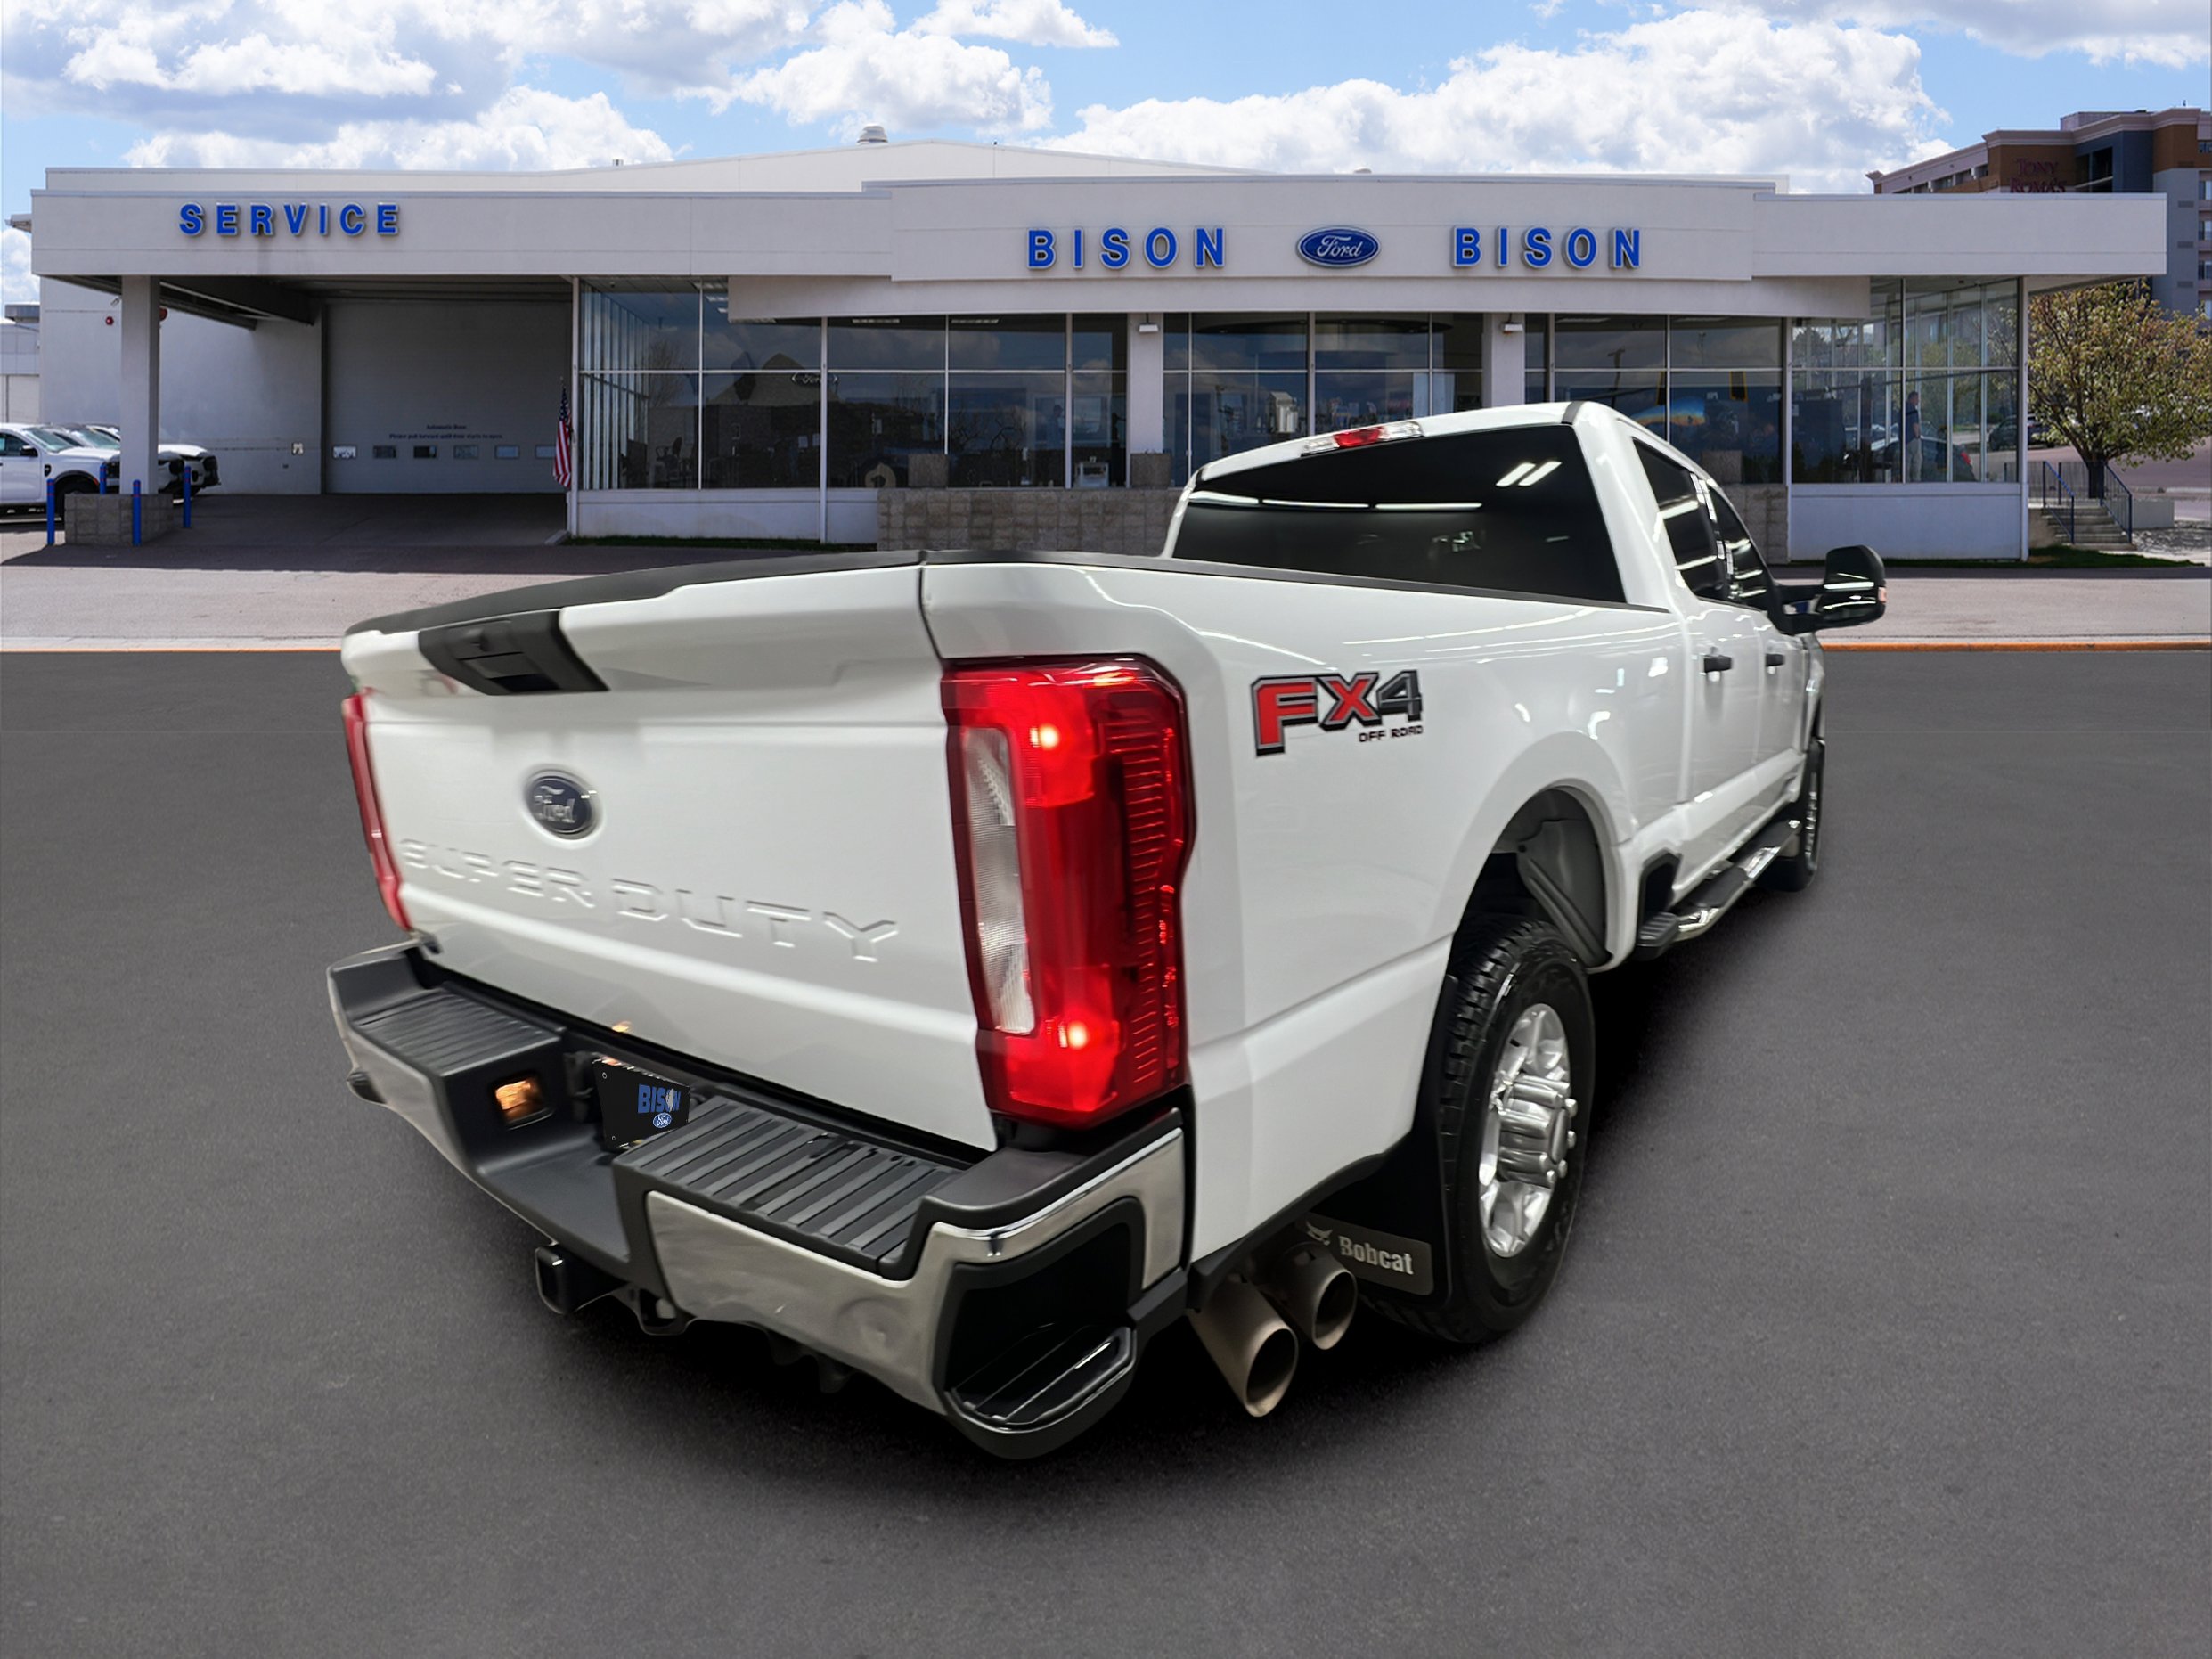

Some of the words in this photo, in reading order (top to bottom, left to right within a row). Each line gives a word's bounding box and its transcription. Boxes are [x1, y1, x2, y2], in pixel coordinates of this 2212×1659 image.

[2015, 157, 2060, 177] TONY
[178, 202, 401, 237] SERVICE
[1026, 225, 1226, 270] BISON
[1317, 234, 1364, 257] Ford
[1451, 225, 1643, 269] BISON
[1251, 670, 1423, 756] FX4
[1359, 731, 1386, 743] OFF
[1391, 725, 1424, 739] ROAD
[535, 785, 575, 823] Ford
[400, 838, 595, 908] SUPER
[612, 878, 899, 962] DUTY
[1338, 1235, 1415, 1275] Bobcat
